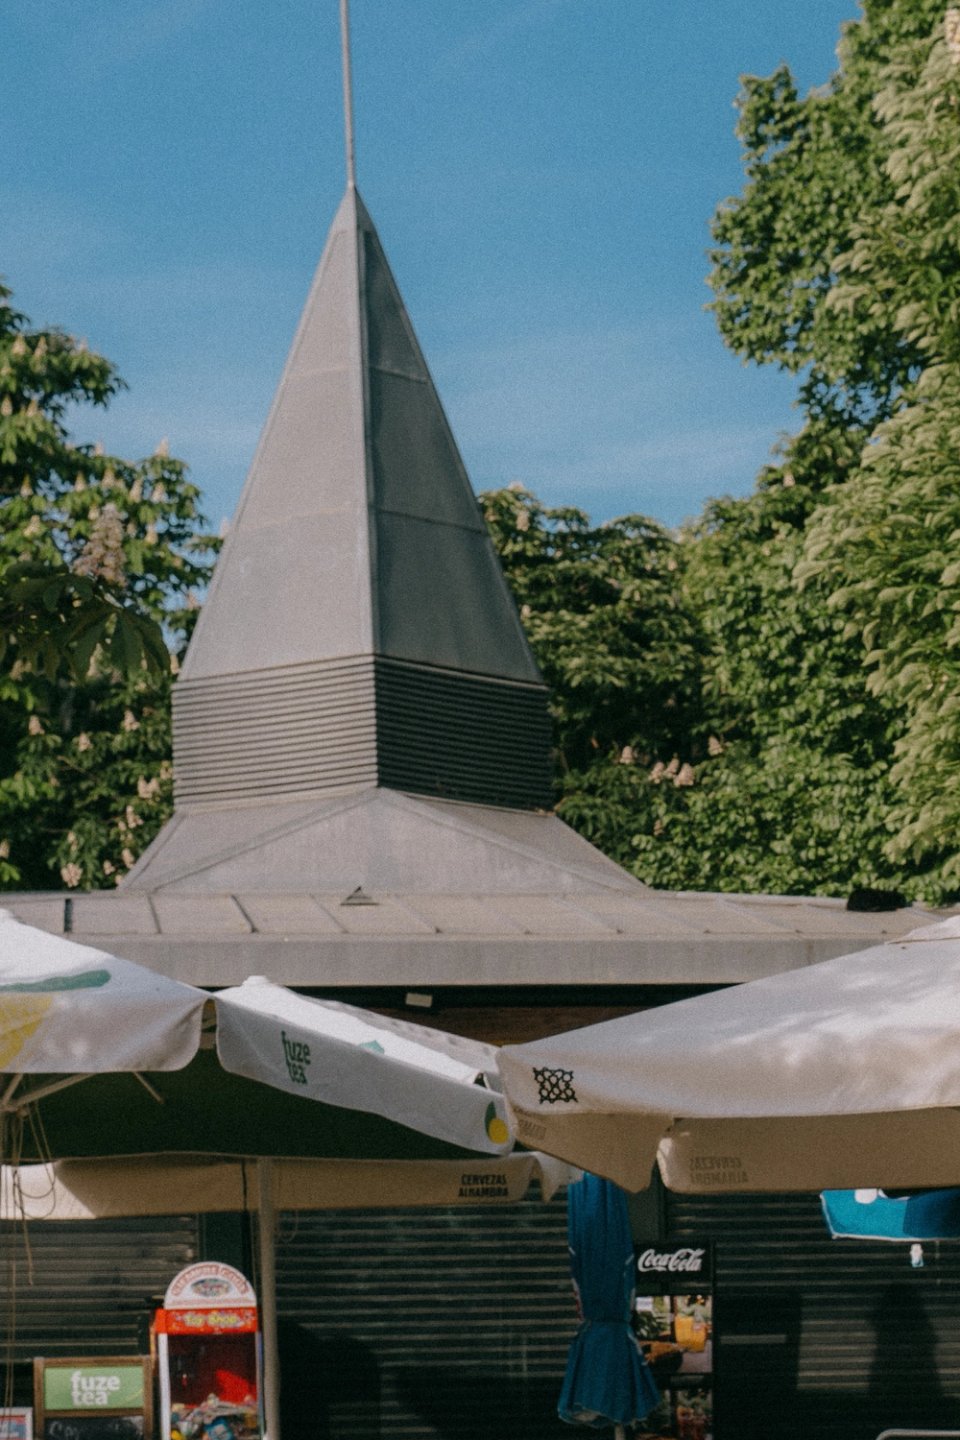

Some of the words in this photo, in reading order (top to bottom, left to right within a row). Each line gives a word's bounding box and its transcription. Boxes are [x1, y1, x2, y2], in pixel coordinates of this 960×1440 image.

[281, 1031, 311, 1065] fuze
[461, 1174, 507, 1186] CERVEZAS
[458, 1187, 509, 1198] ALHAMBRA
[70, 1370, 121, 1391] fuze
[71, 1388, 109, 1406] tea
